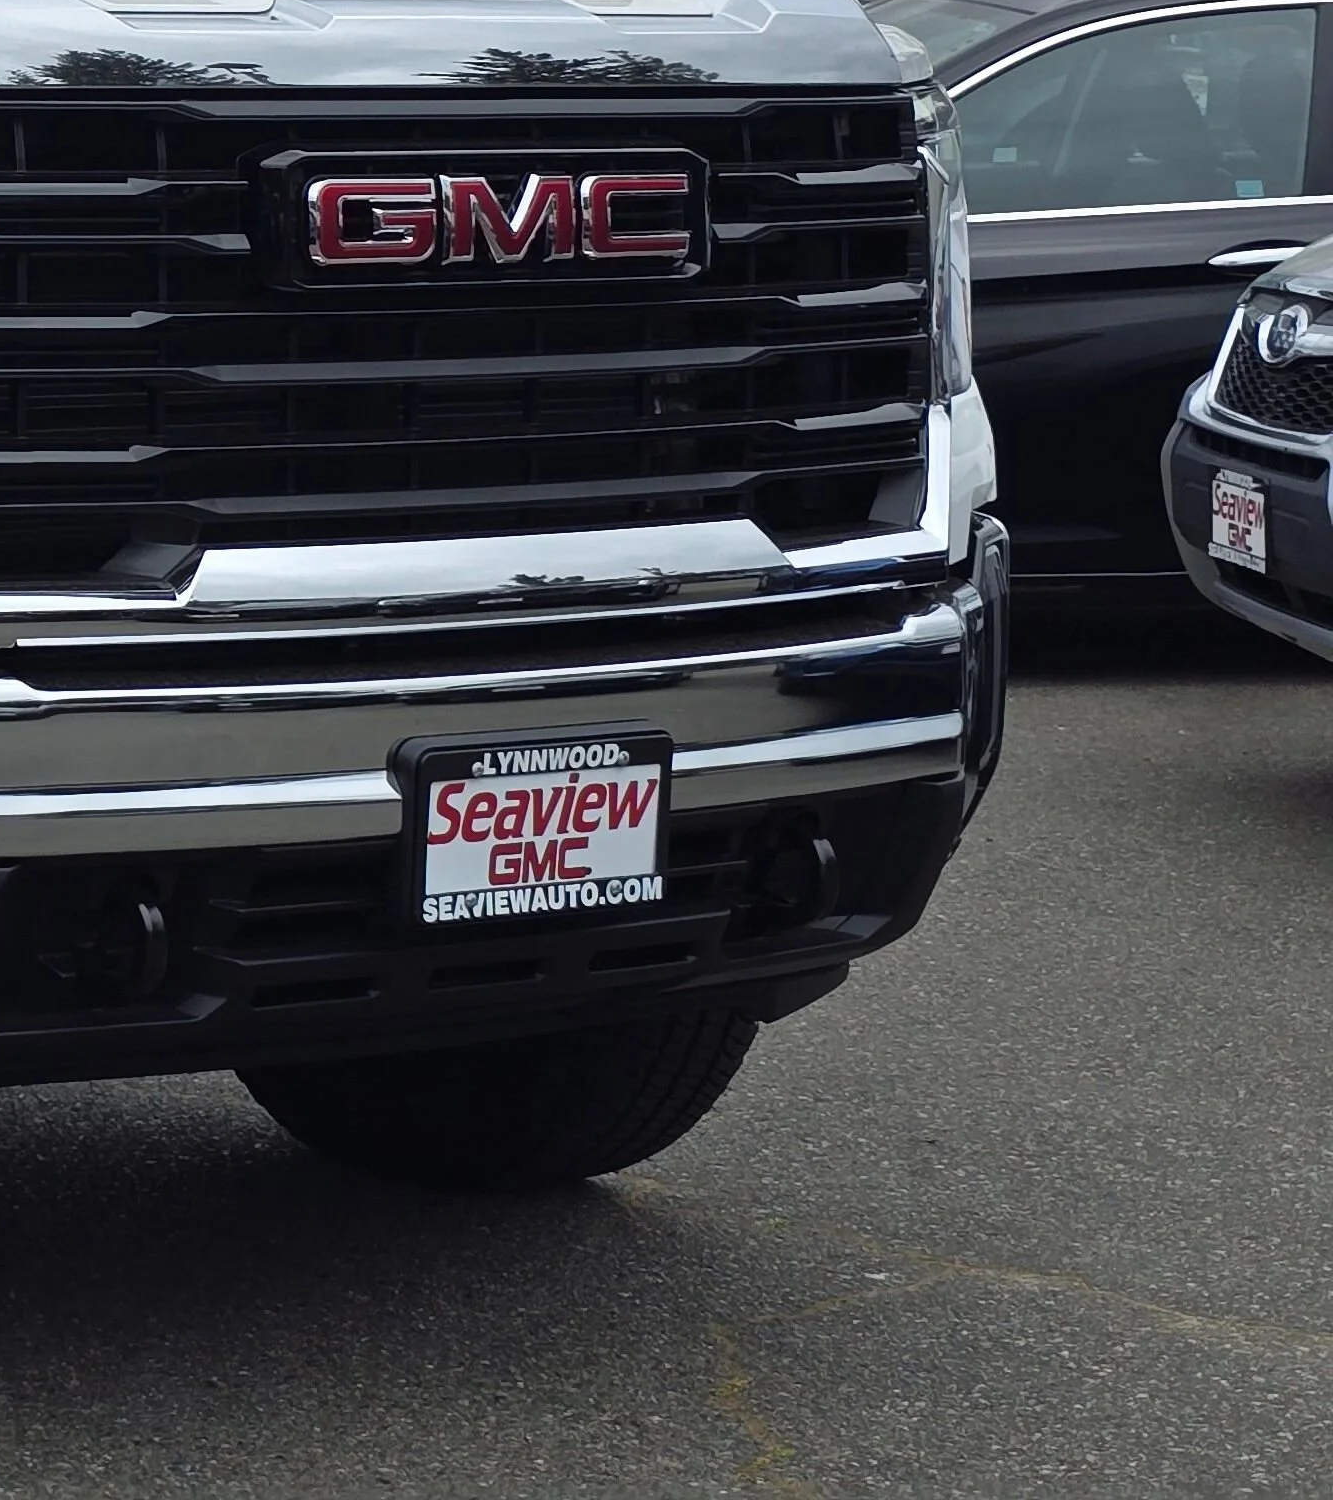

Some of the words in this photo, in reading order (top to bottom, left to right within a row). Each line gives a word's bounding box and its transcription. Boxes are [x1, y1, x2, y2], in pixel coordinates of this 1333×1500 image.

[307, 172, 692, 266] GMC
[1212, 482, 1263, 529] Seaview
[483, 743, 620, 775] LYNNWOOD
[427, 772, 659, 845] Seaview
[488, 836, 592, 886] GMC
[422, 875, 664, 924] SEAVIEWAUTO.COM
